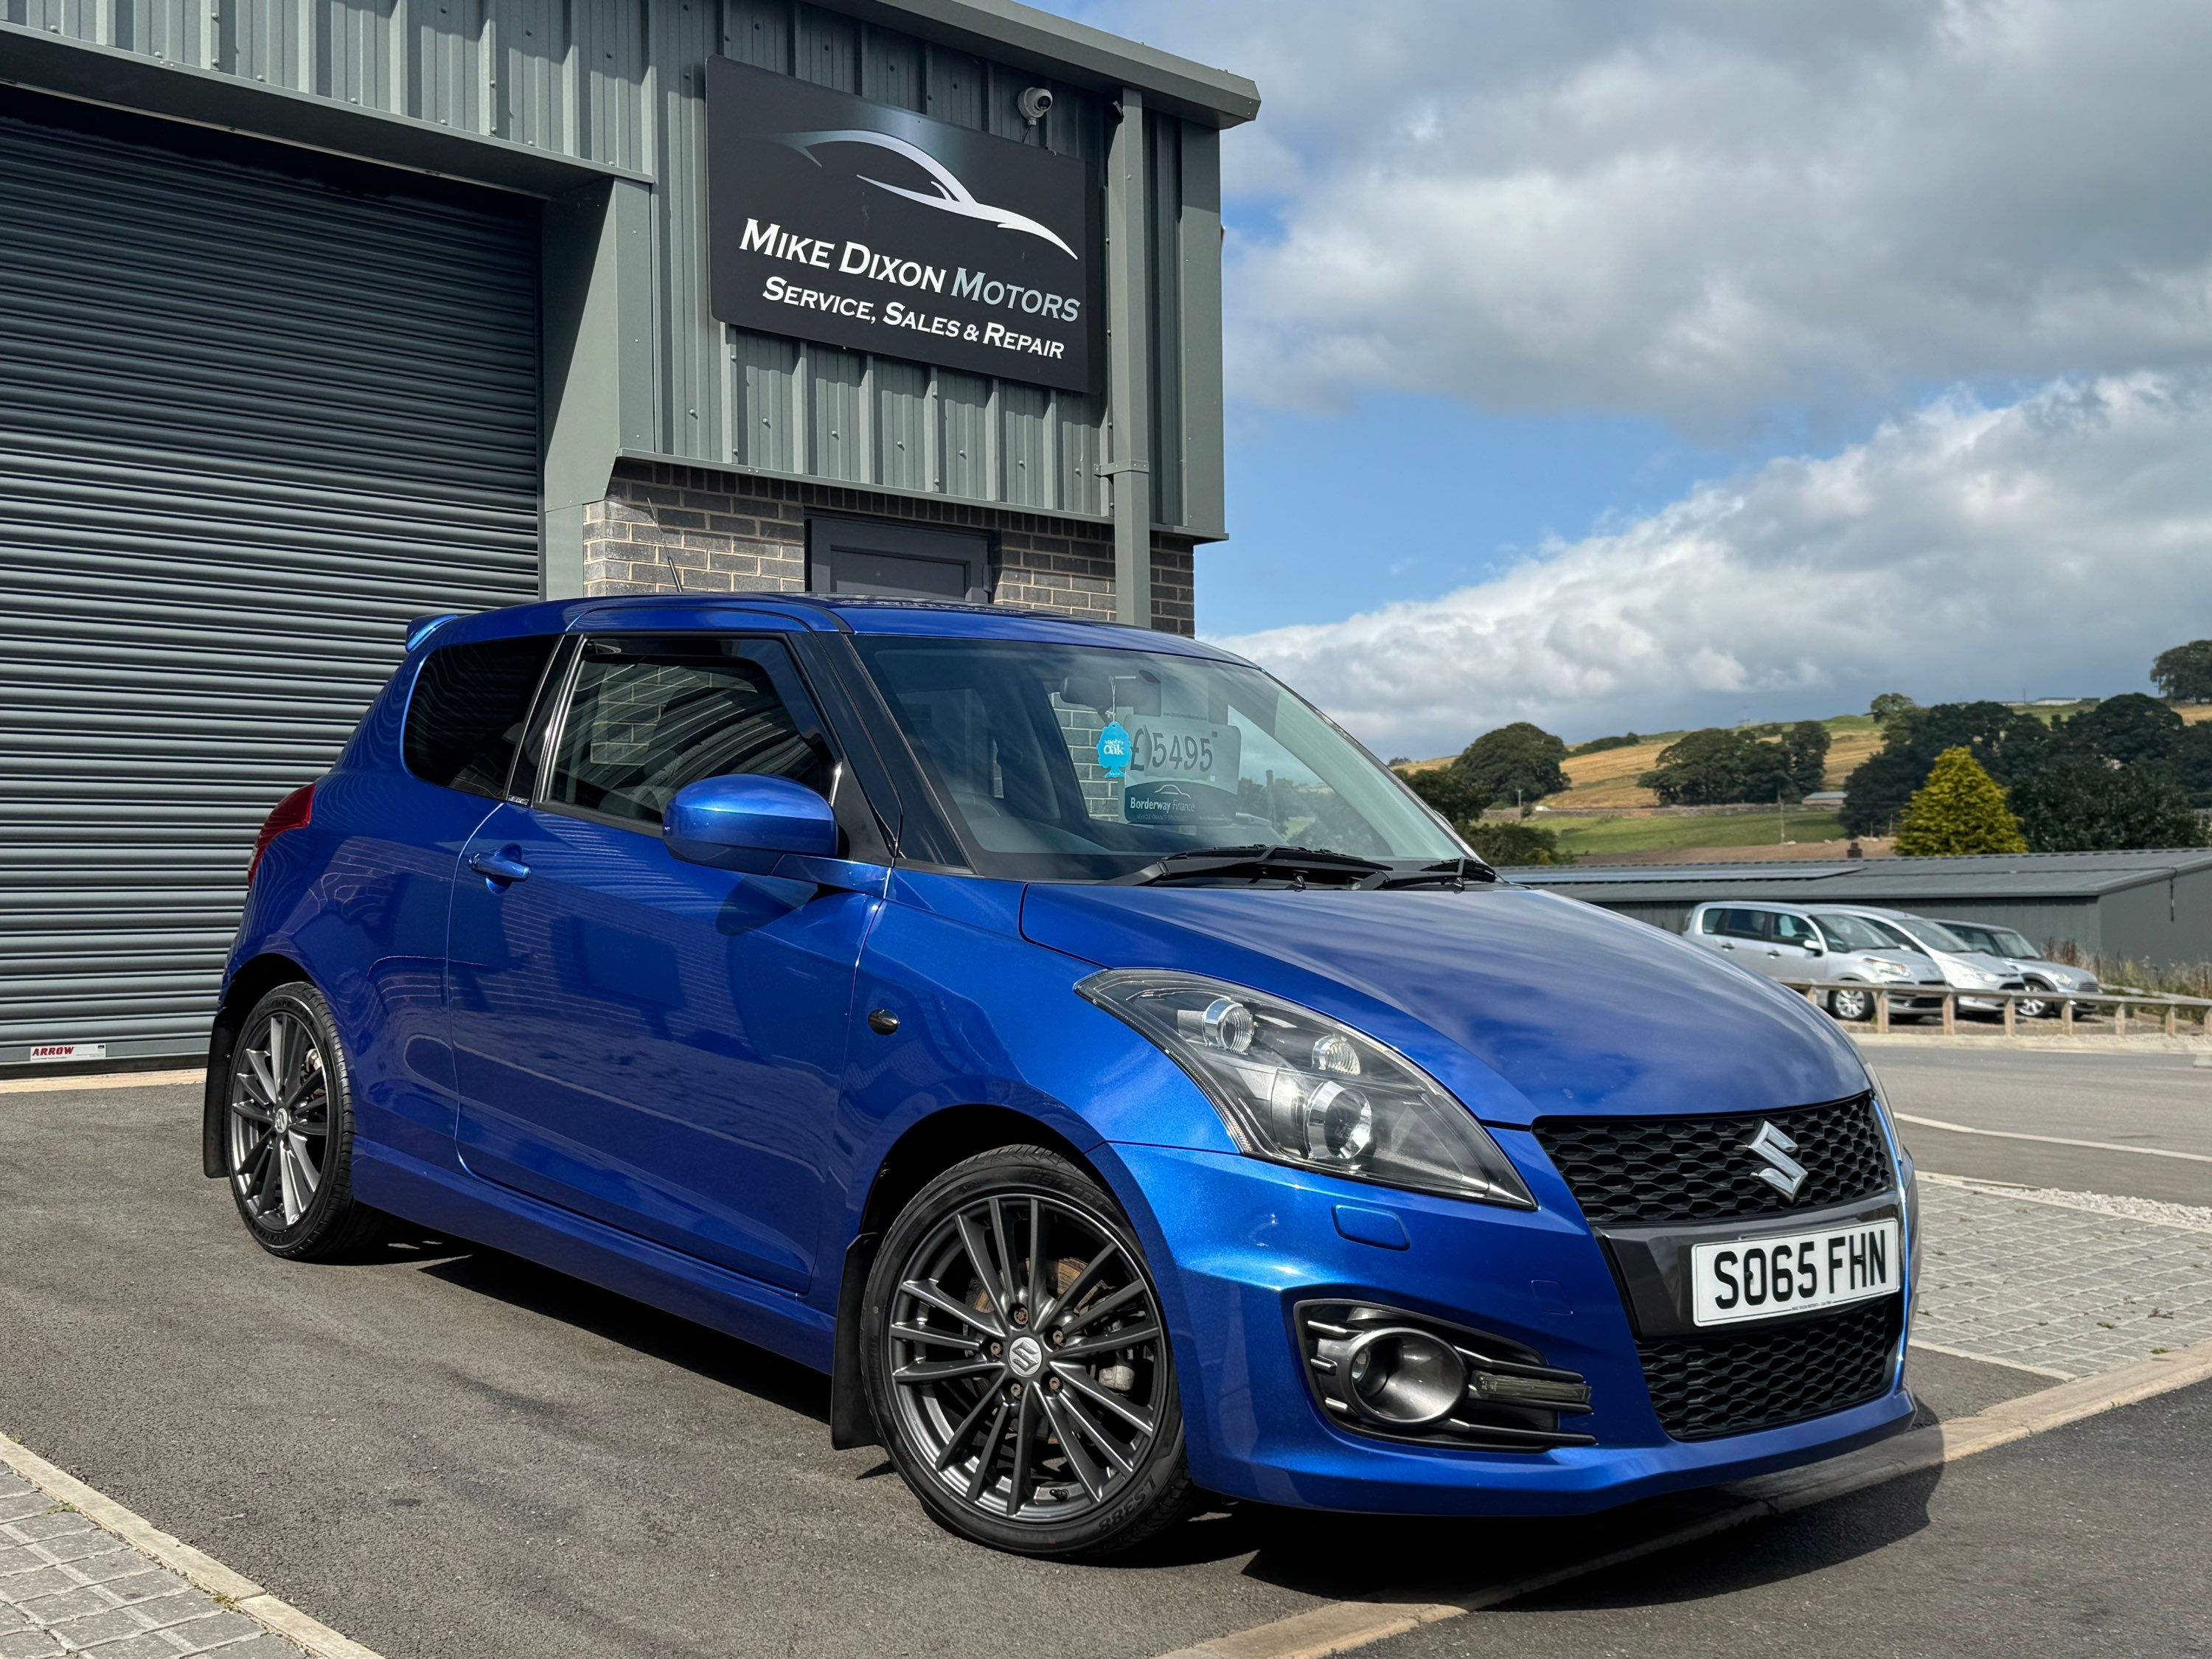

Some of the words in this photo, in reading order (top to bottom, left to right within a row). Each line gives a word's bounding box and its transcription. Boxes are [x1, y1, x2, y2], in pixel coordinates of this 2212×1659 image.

[739, 218, 835, 270] MIKE
[839, 241, 946, 293] DIXON
[950, 267, 1081, 322] MOTORS
[762, 275, 877, 324] SERVICE,
[882, 301, 961, 338] SALES
[963, 324, 979, 341] &
[982, 321, 1065, 359] REPAIR
[1103, 744, 1124, 756] Oak
[1130, 796, 1171, 813] Borderway
[1172, 799, 1196, 813] Finance
[32, 1046, 74, 1056] ARROW
[1828, 1229, 1886, 1294] FHN
